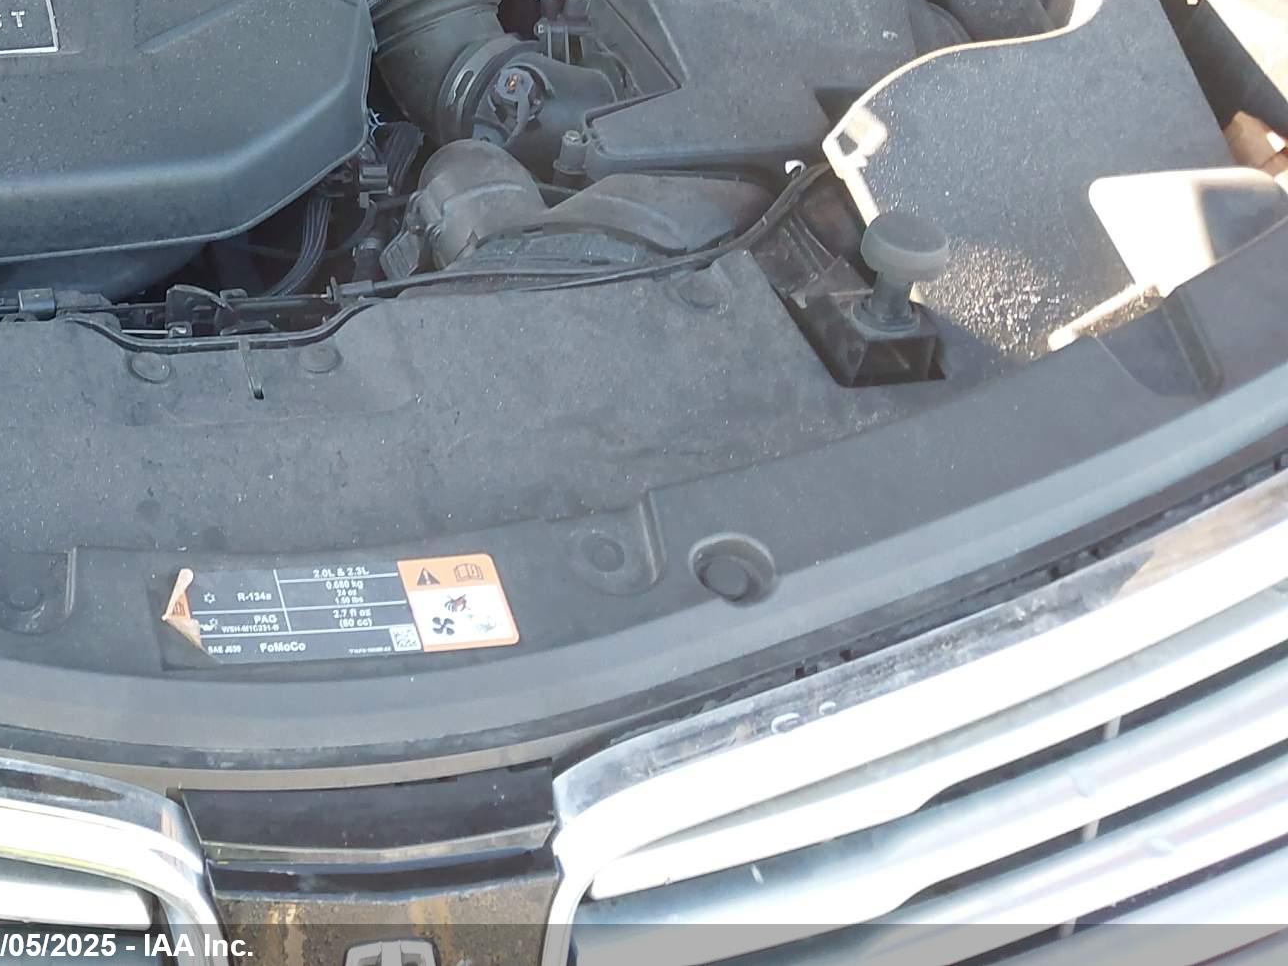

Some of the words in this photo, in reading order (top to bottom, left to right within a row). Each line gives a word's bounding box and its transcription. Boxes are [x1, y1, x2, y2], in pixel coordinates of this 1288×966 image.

[313, 569, 335, 579] 2.0L
[337, 568, 345, 577] &
[346, 567, 369, 576] 2.3L
[350, 579, 364, 590] kg
[236, 591, 272, 602] R-134a
[253, 614, 277, 624] PAG
[259, 641, 306, 653] FoMoCo
